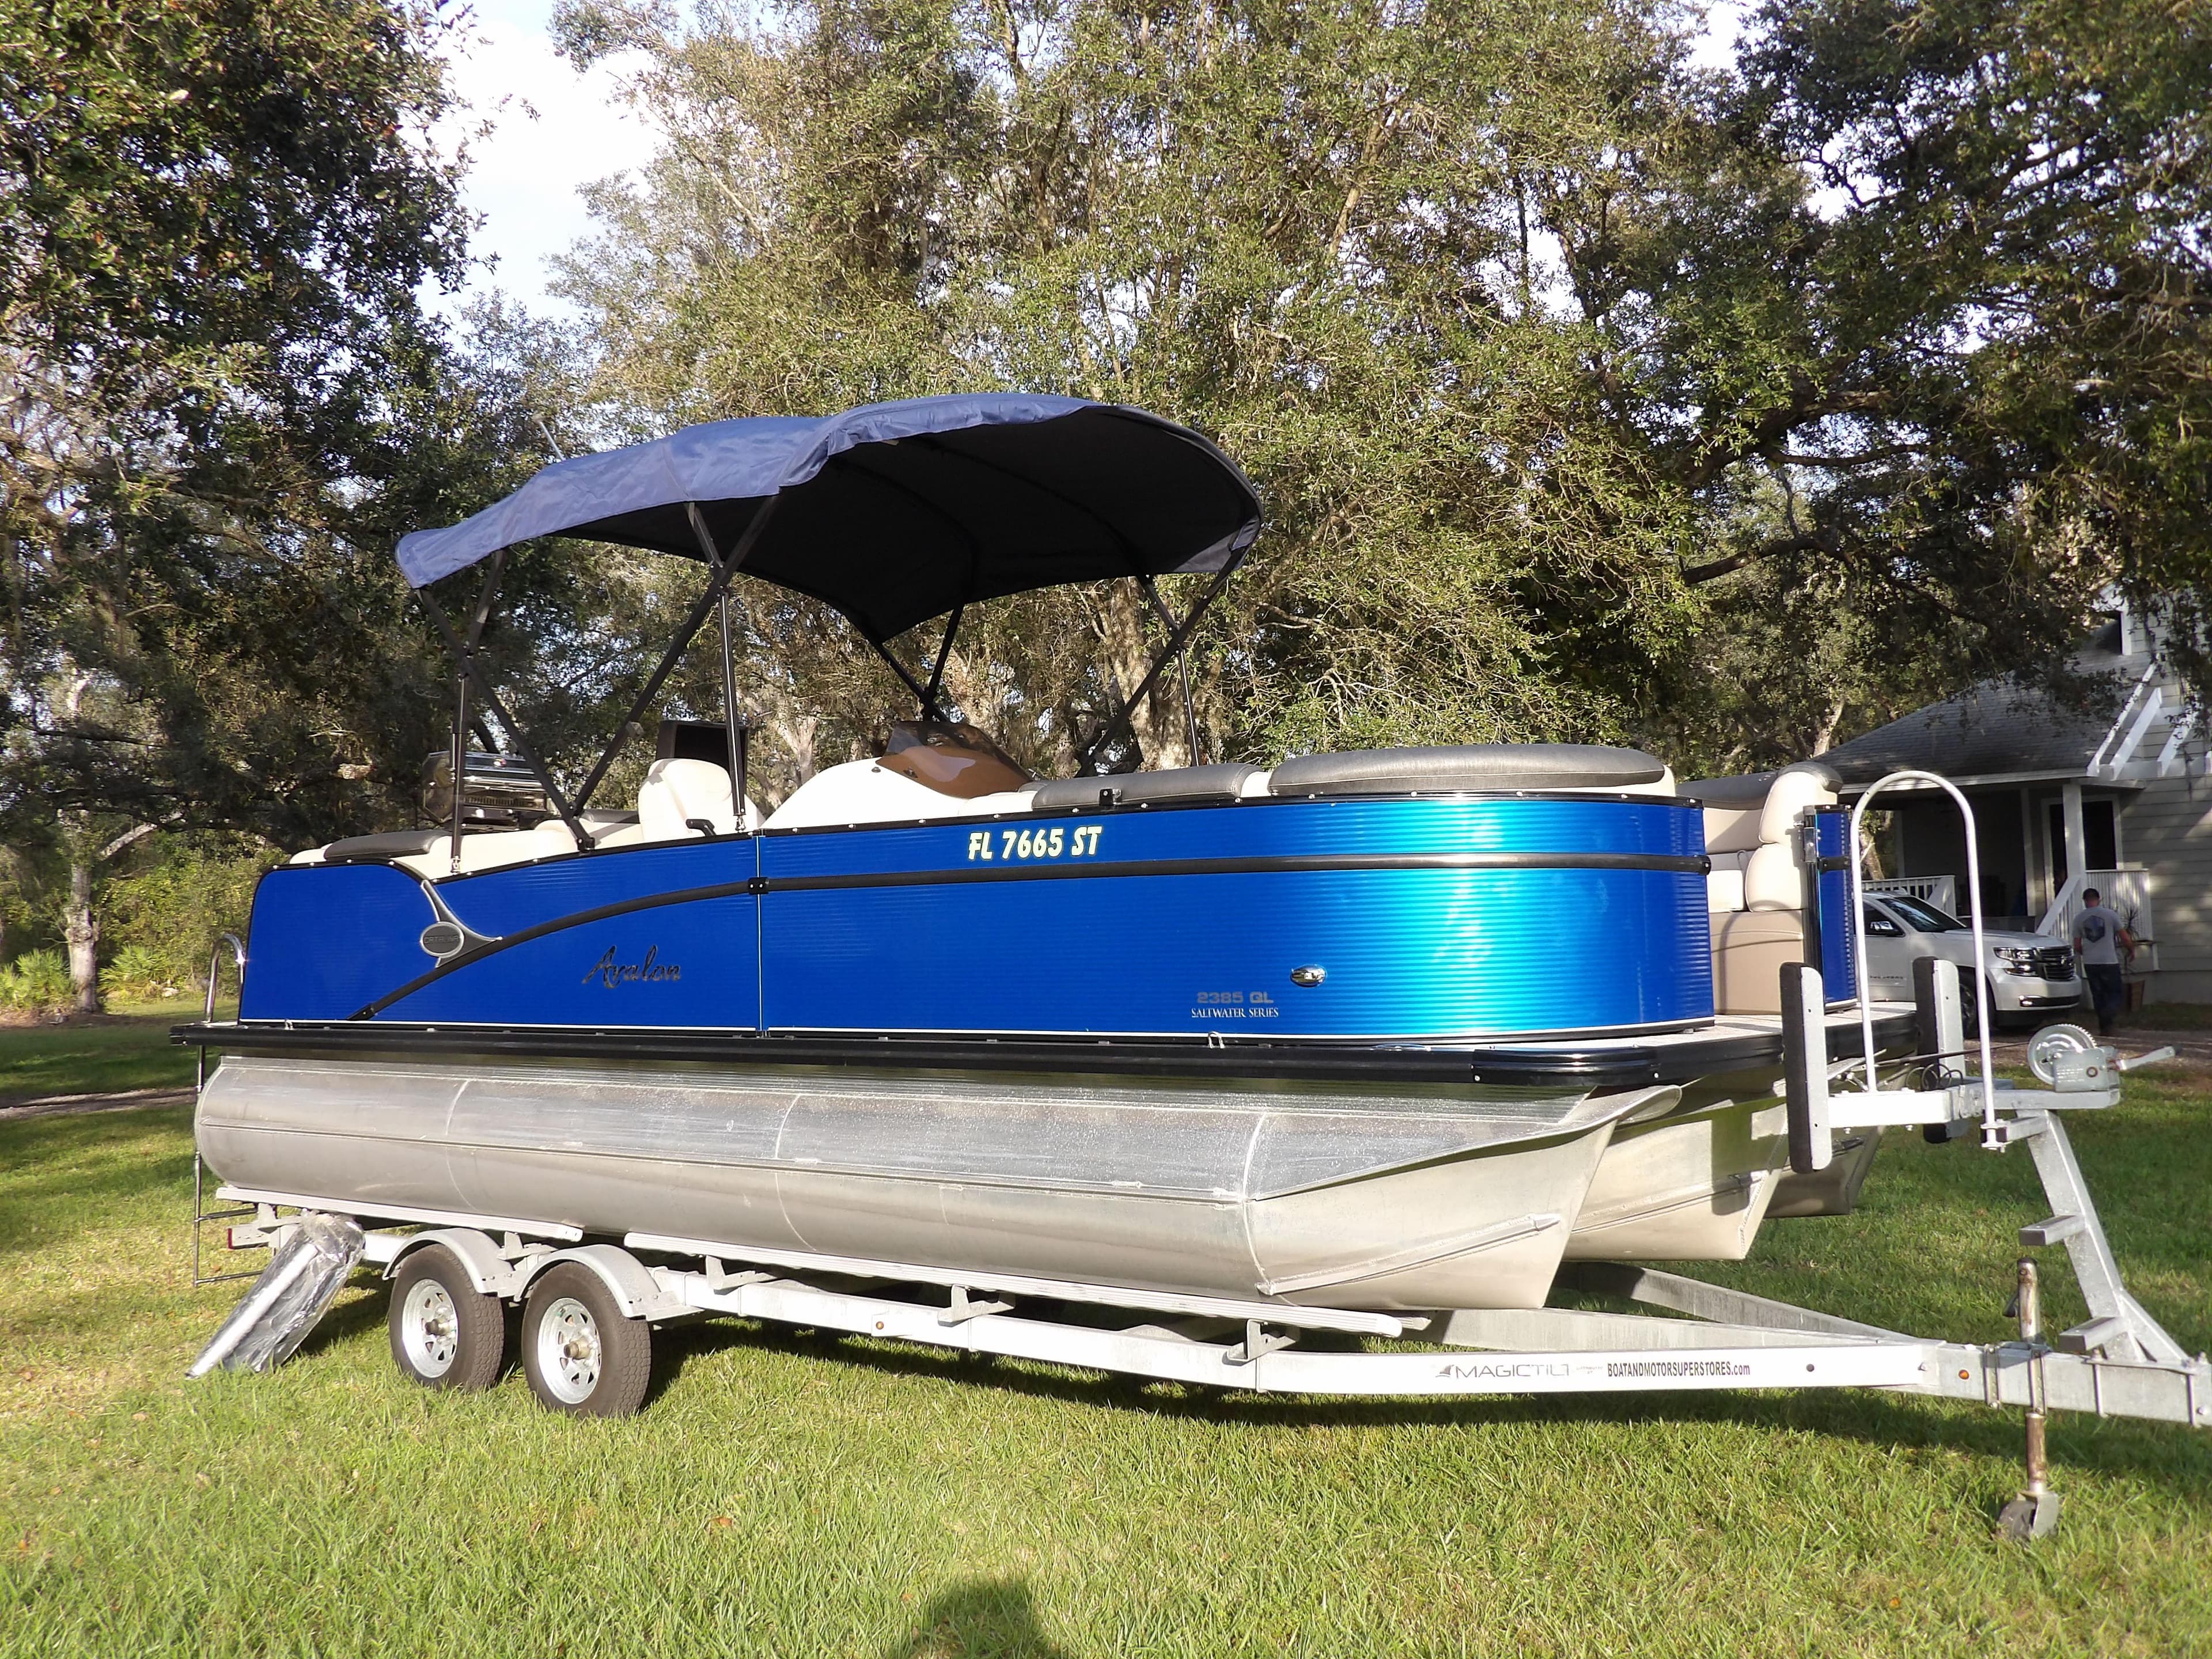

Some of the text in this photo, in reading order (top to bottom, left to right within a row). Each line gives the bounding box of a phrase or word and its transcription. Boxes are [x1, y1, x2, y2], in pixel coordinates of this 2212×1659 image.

[967, 825, 1103, 860] FL 7665 ST
[582, 944, 681, 990] Avalon
[1197, 991, 1244, 1004] 2385
[1191, 1007, 1279, 1018] SALTWATER SERIES
[1607, 1361, 1750, 1377] BOATANDMOTORSUPERSTORES.com
